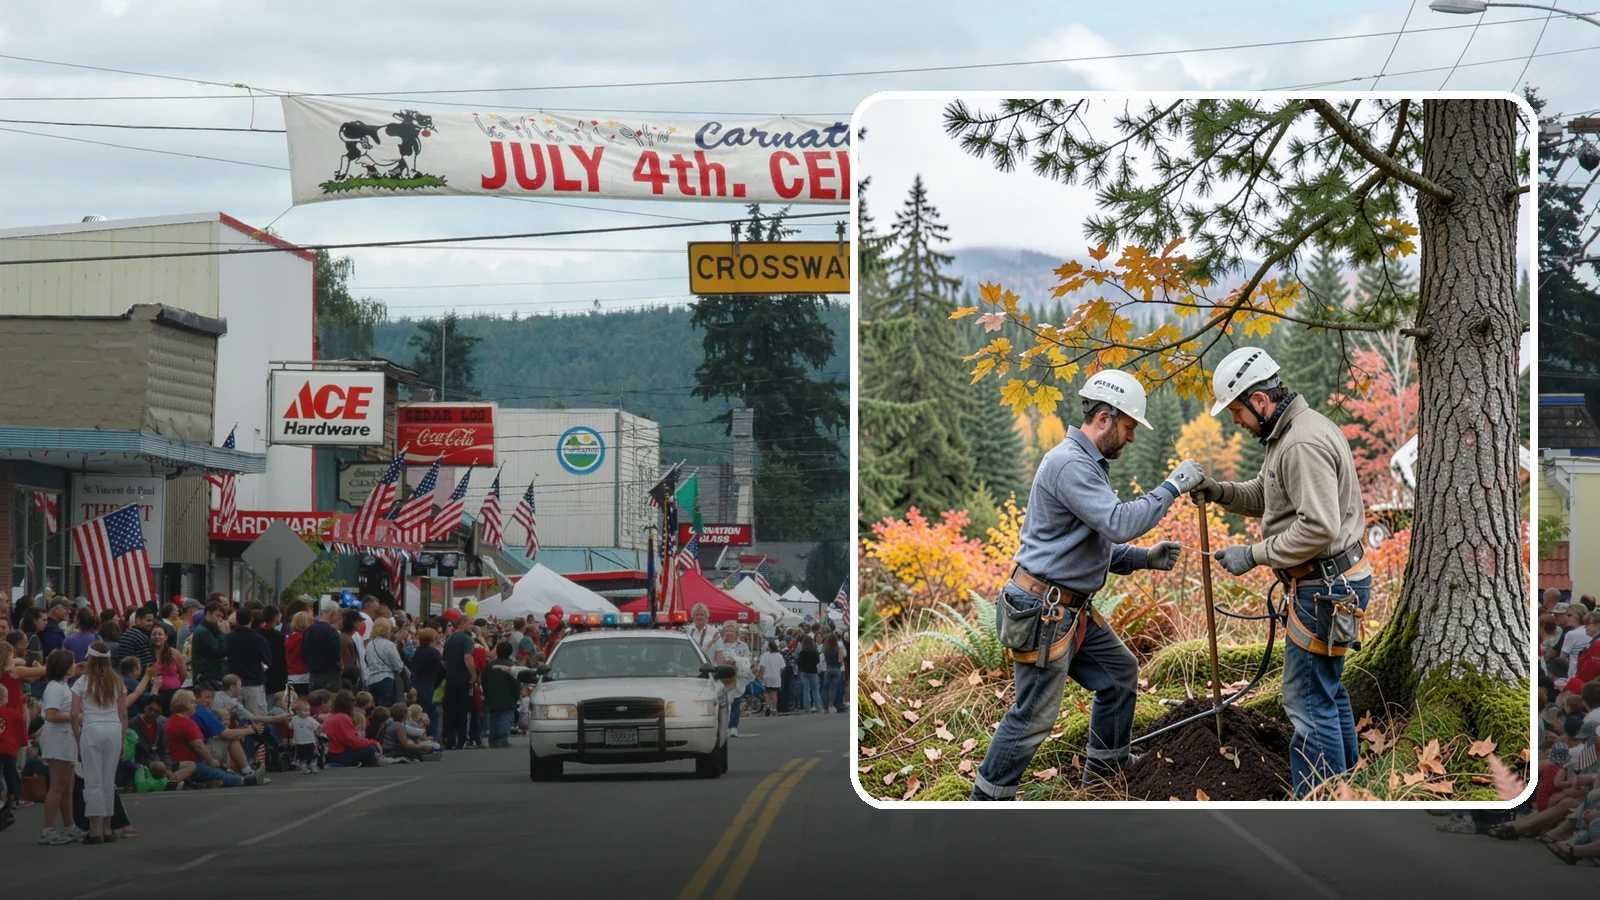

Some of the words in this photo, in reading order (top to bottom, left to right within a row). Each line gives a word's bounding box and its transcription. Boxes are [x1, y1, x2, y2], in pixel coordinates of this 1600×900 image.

[481, 141, 603, 192] JULY
[631, 150, 746, 198] 4th.
[696, 254, 850, 280] CROSSWA
[283, 380, 373, 420] ACE
[406, 410, 452, 422] CEDAR
[284, 421, 371, 437] Hardware
[95, 485, 124, 495] Vincent
[126, 486, 136, 495] de
[137, 486, 155, 495] Paul
[699, 535, 730, 543] GLASS
